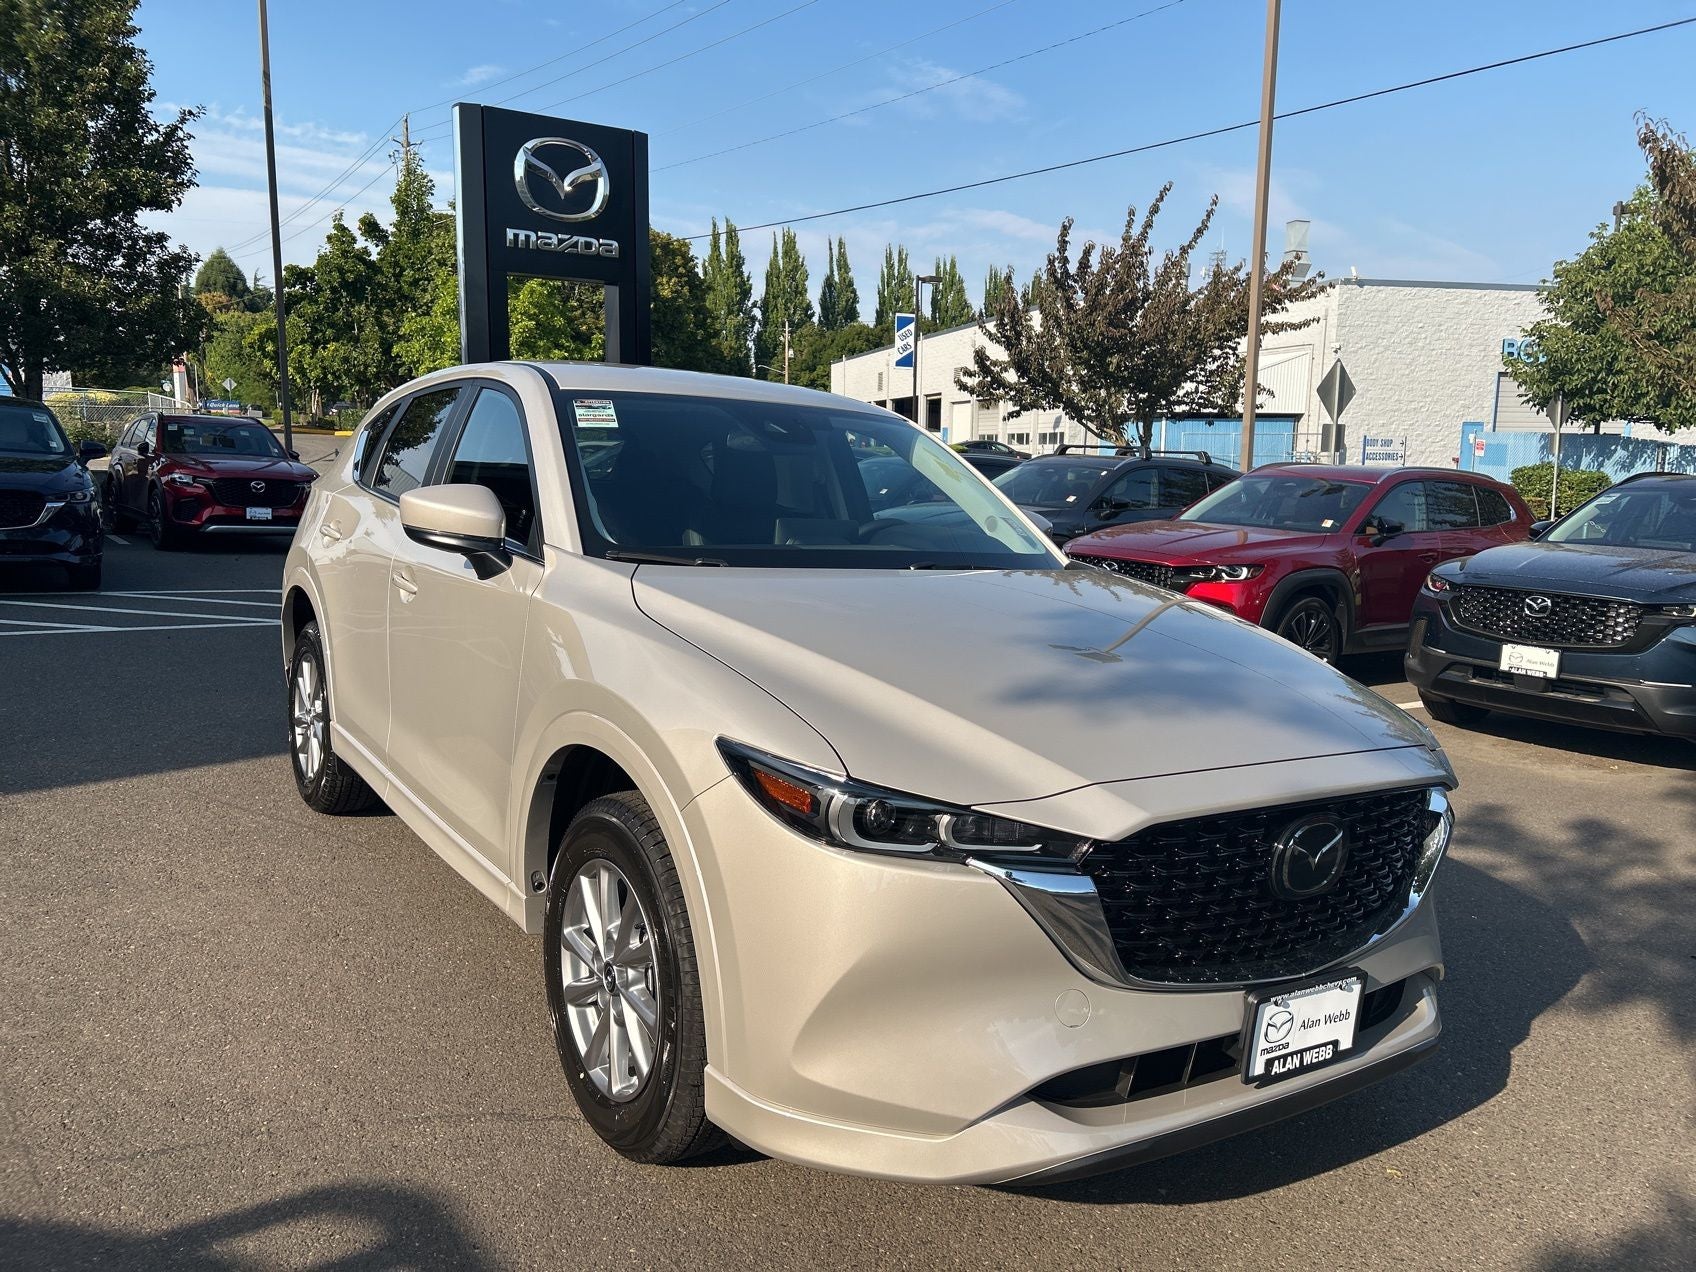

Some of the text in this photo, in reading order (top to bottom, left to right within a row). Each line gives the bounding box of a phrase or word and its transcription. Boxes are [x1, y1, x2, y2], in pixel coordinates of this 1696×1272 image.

[506, 227, 620, 258] mazda
[897, 329, 913, 342] USED
[897, 342, 913, 355] CARS
[1366, 438, 1393, 447] BODY SHOP
[1365, 452, 1399, 461] ACCESSORIES
[1299, 1008, 1351, 1031] Alan Webb
[1260, 1041, 1290, 1056] mazda
[1271, 1044, 1333, 1075] ALAN WEBB
